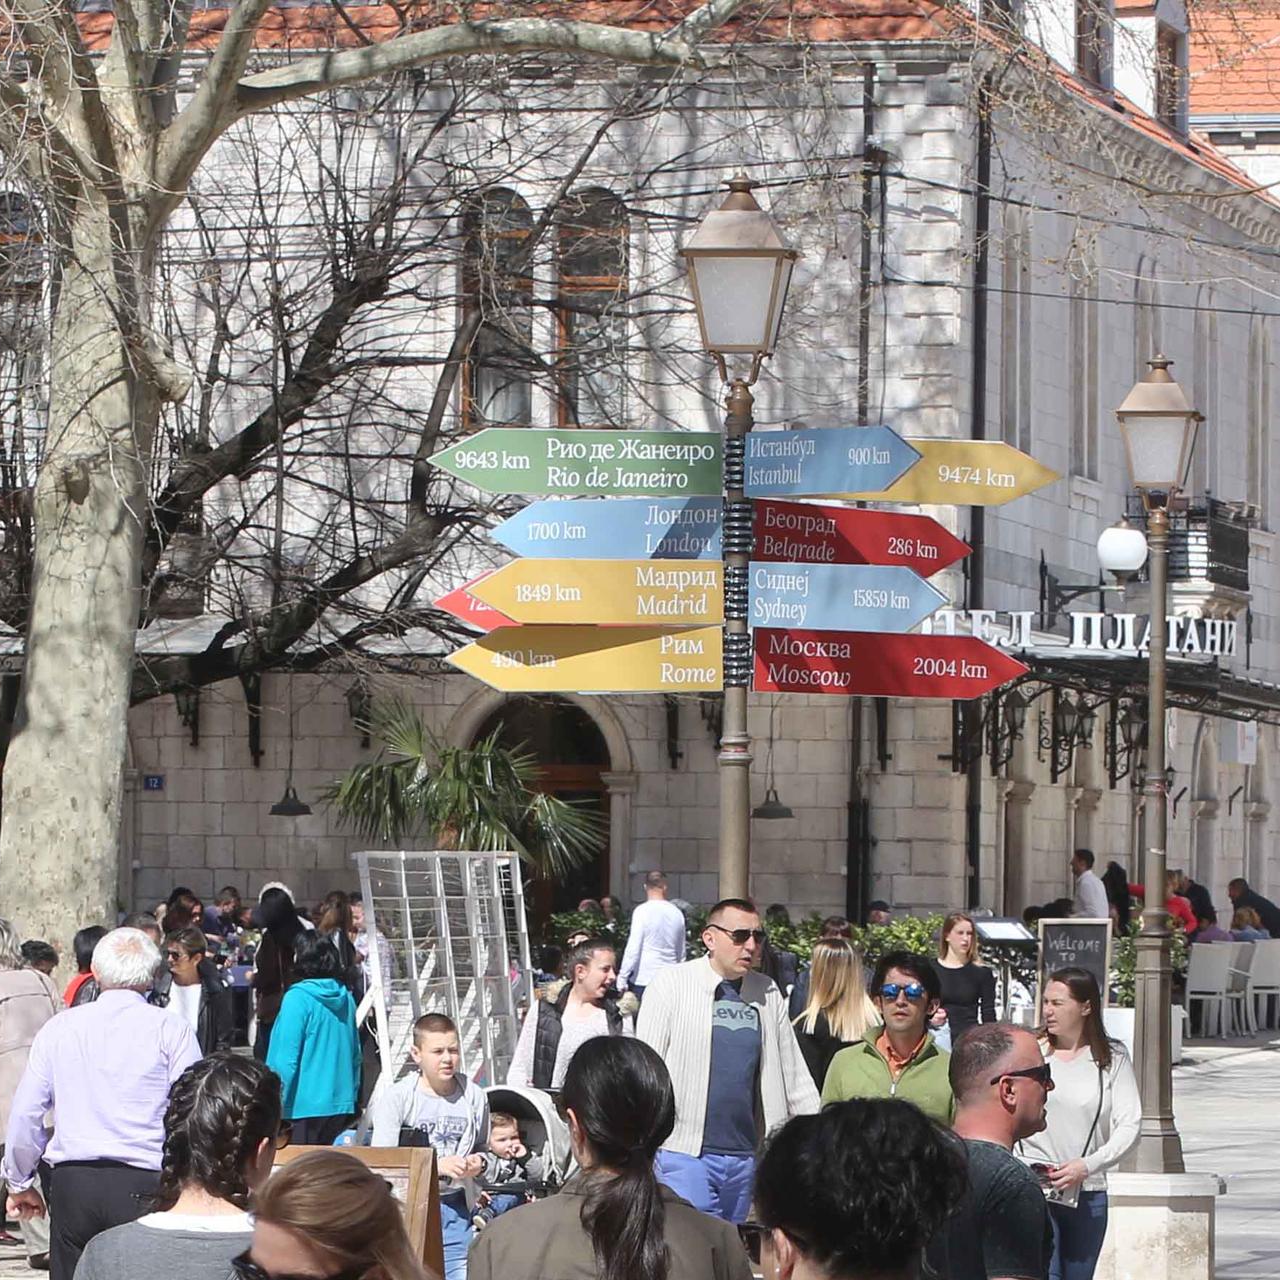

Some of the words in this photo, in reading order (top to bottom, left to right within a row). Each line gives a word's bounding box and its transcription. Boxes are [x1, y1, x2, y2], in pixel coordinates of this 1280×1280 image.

[547, 438, 586, 460] Рио
[589, 444, 614, 465] де
[750, 435, 815, 462] Истанбул
[848, 448, 870, 465] 900
[873, 446, 890, 464] km
[455, 450, 498, 469] 9643
[503, 451, 530, 469] km
[547, 467, 580, 487] Rio
[585, 467, 608, 488] de
[612, 468, 688, 488] Janeiro
[748, 463, 801, 486] Istanbul
[938, 465, 982, 484] 9474
[986, 466, 1015, 488] km
[645, 505, 718, 527] Лондон
[765, 507, 836, 537] Београд
[528, 522, 559, 540] 1700
[563, 522, 586, 540] km
[645, 533, 712, 553] London
[763, 535, 835, 562] Belgrade
[888, 537, 912, 555] 286
[916, 537, 937, 559] km
[635, 567, 717, 592] Мадрид
[755, 569, 810, 597] Сиднеј
[515, 584, 551, 602] 1849
[556, 583, 580, 601] km
[853, 590, 888, 609] 15859
[890, 590, 910, 609] km
[637, 595, 706, 615] Madrid
[754, 598, 807, 625] Sydney
[922, 609, 1035, 648] ТЕЛ
[660, 635, 703, 655] Рим
[770, 635, 851, 659] Москва
[491, 650, 523, 668] 490
[528, 650, 556, 668] km
[913, 658, 957, 677] 2004
[960, 658, 987, 679] km
[660, 663, 716, 683] Rome
[767, 663, 851, 687] Moscow
[1047, 932, 1100, 952] WELCOME
[1059, 952, 1076, 961] TO
